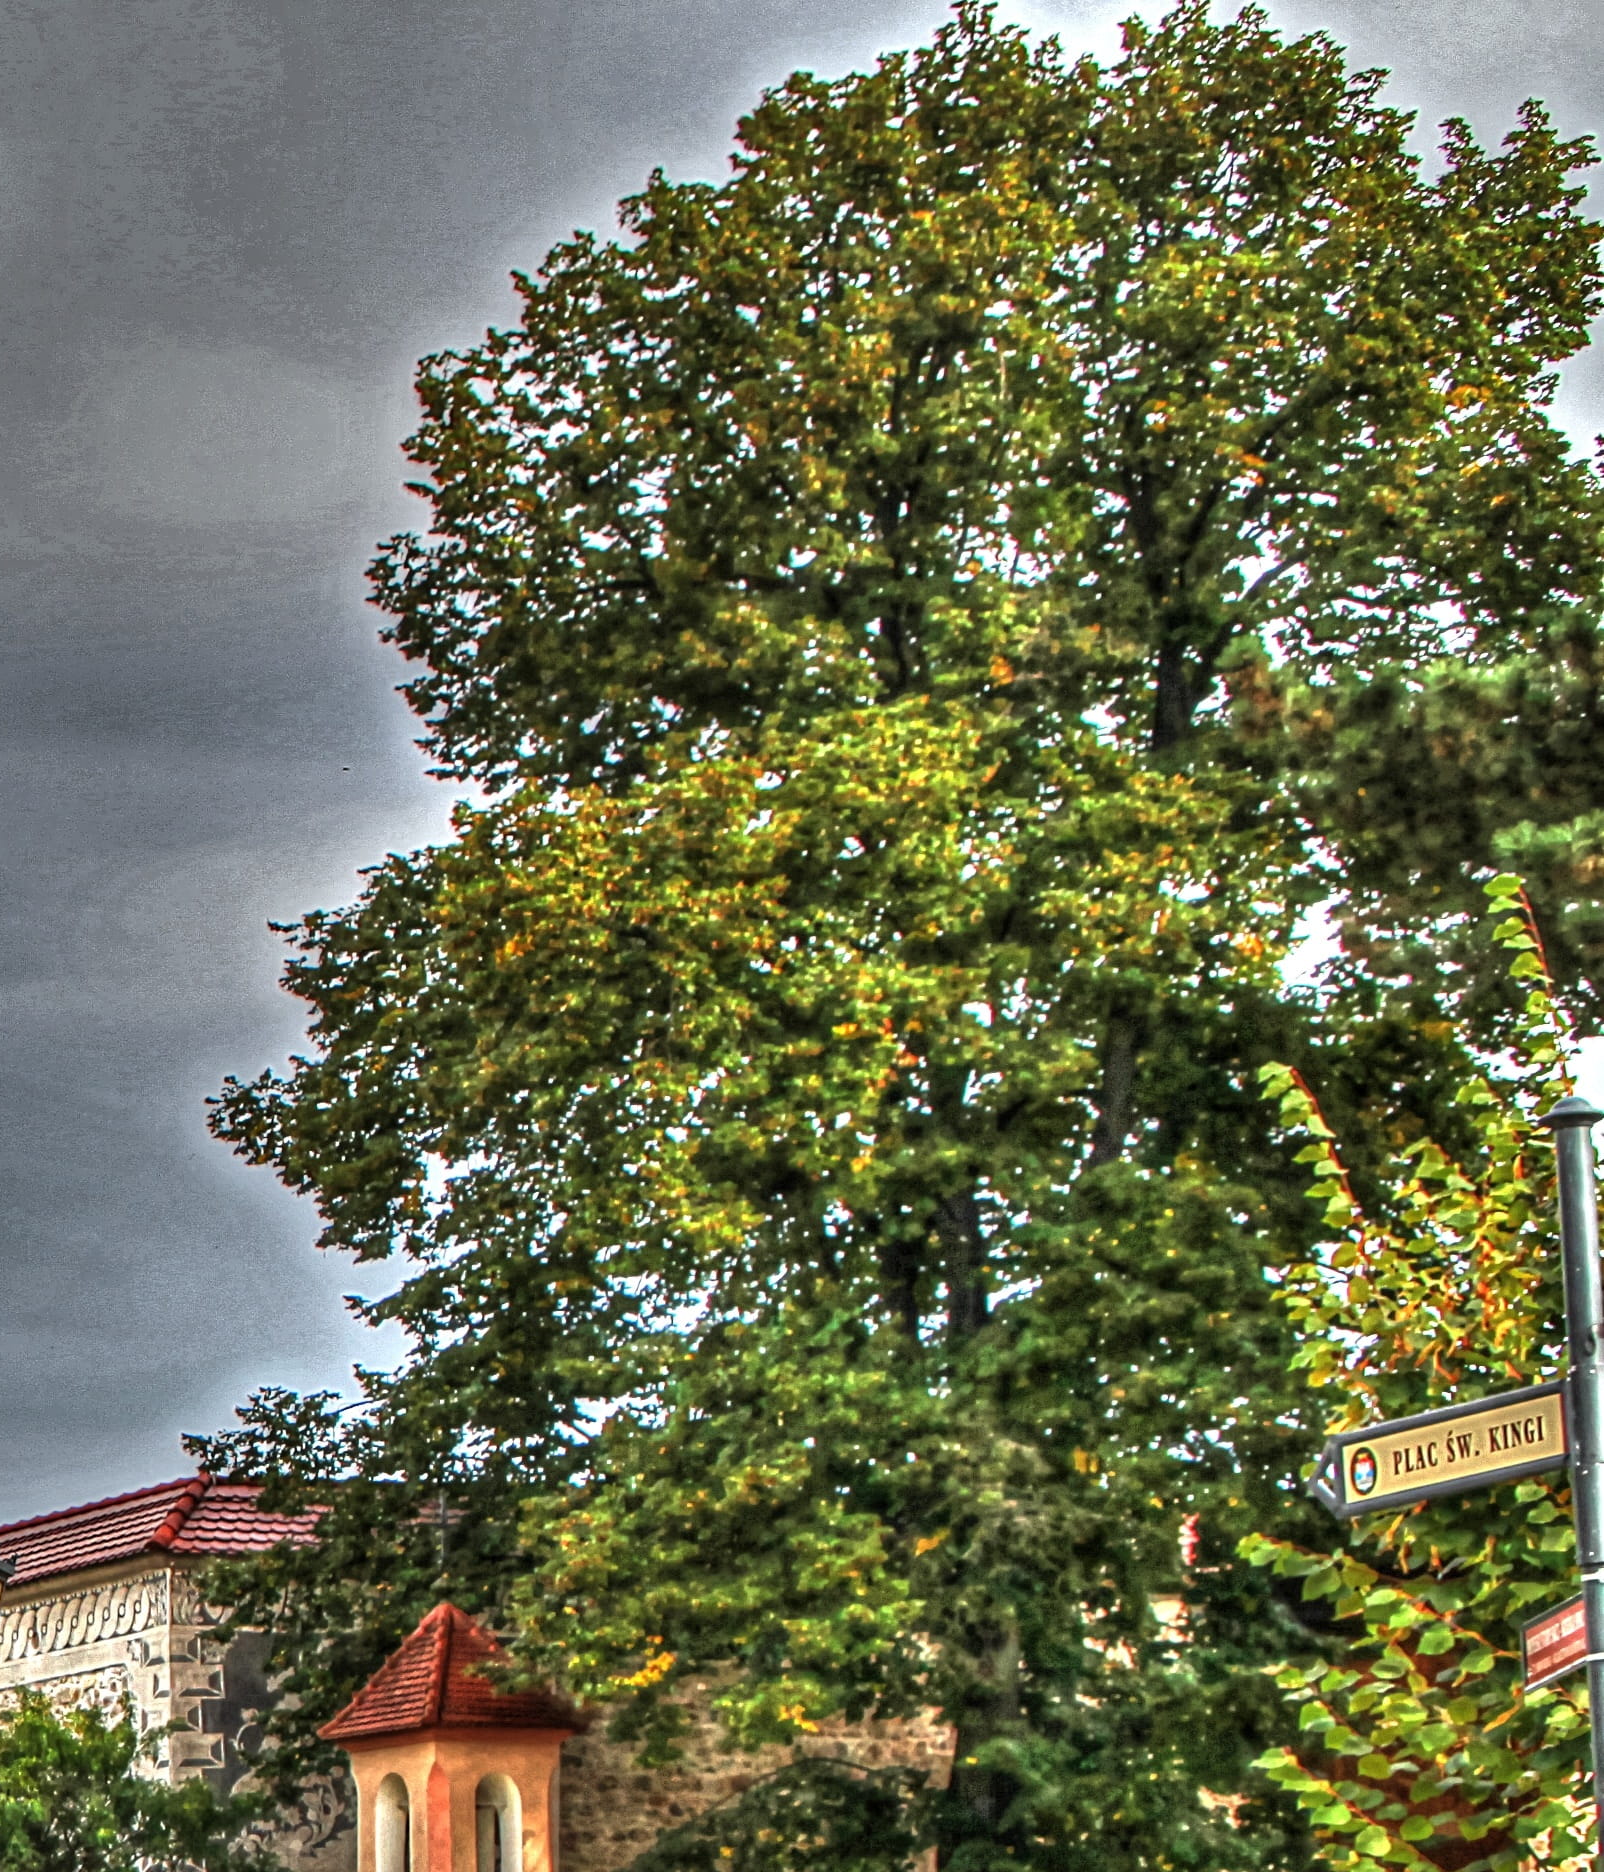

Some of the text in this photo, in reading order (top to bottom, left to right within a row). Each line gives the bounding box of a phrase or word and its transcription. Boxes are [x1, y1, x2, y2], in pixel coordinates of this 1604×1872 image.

[1393, 1415, 1545, 1475] PLAC ŚW. KINGI
